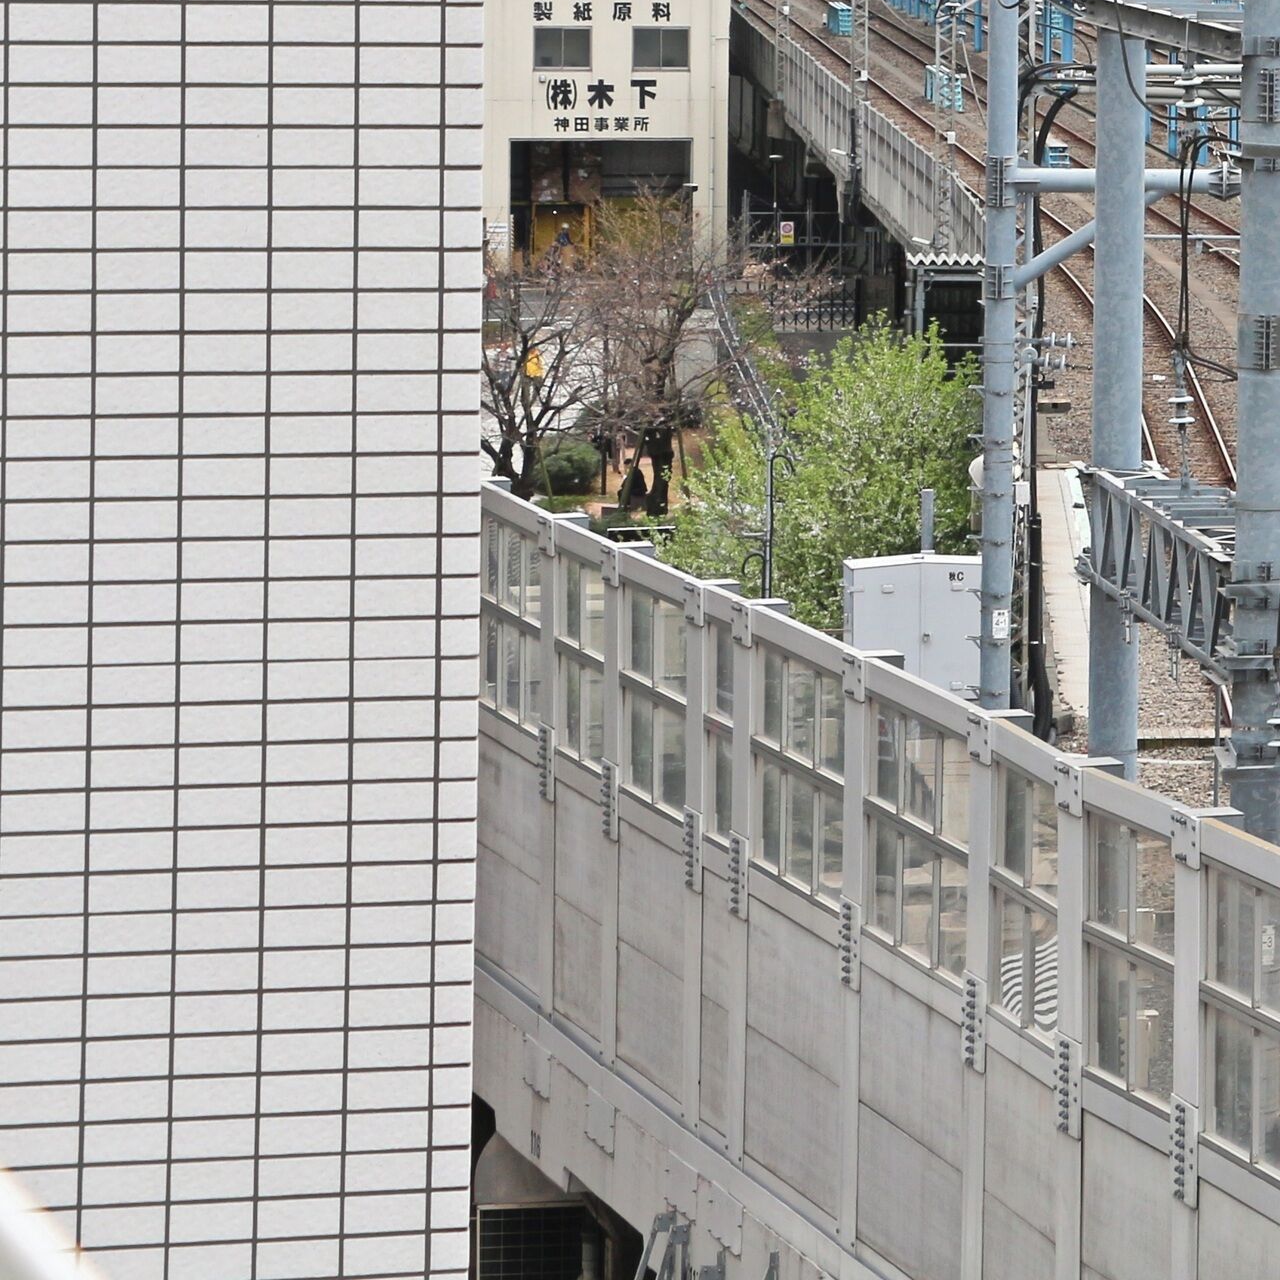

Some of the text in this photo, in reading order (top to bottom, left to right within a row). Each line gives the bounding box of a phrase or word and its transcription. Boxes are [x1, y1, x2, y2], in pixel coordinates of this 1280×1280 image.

[534, 1, 671, 22] 製紙原料
[554, 116, 649, 132] 神田事業所
